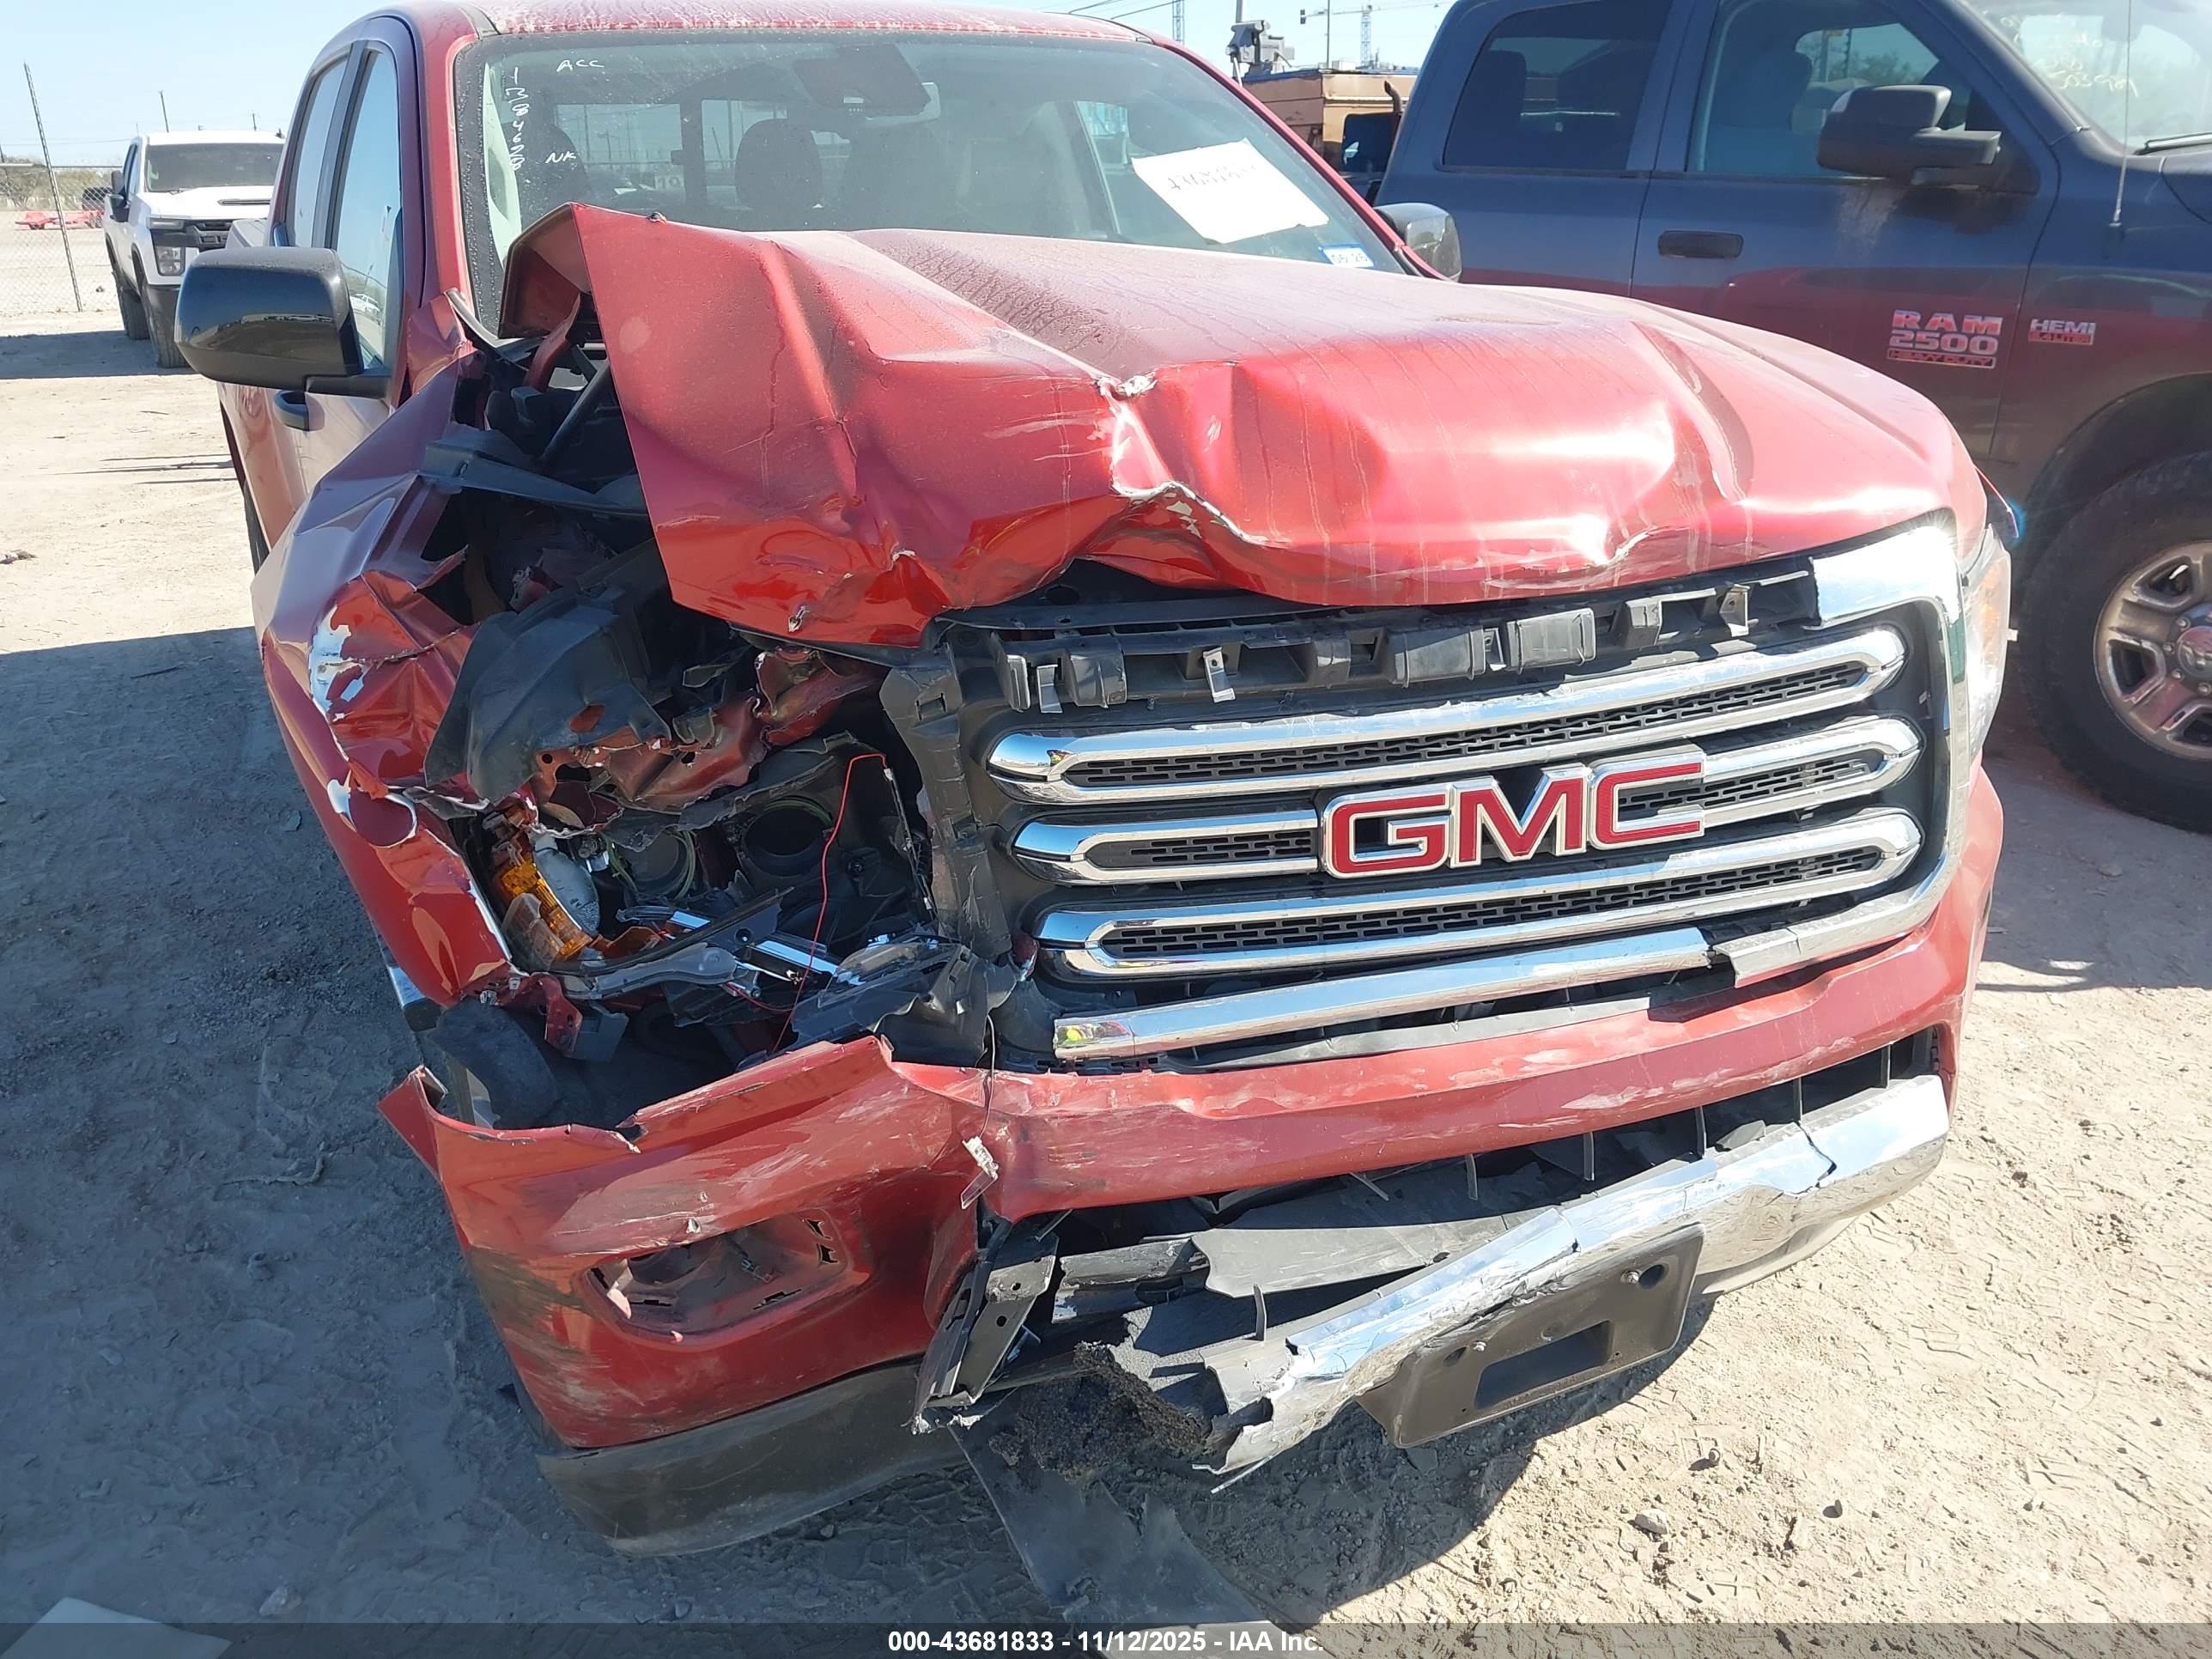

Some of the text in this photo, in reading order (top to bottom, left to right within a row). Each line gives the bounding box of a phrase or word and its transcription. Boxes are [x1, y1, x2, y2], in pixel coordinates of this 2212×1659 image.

[556, 59, 605, 72] ACC
[1892, 309, 2003, 335] RAM
[2030, 319, 2096, 336] HEMI
[1888, 330, 1999, 355] 2500
[1321, 752, 1705, 878] GMC
